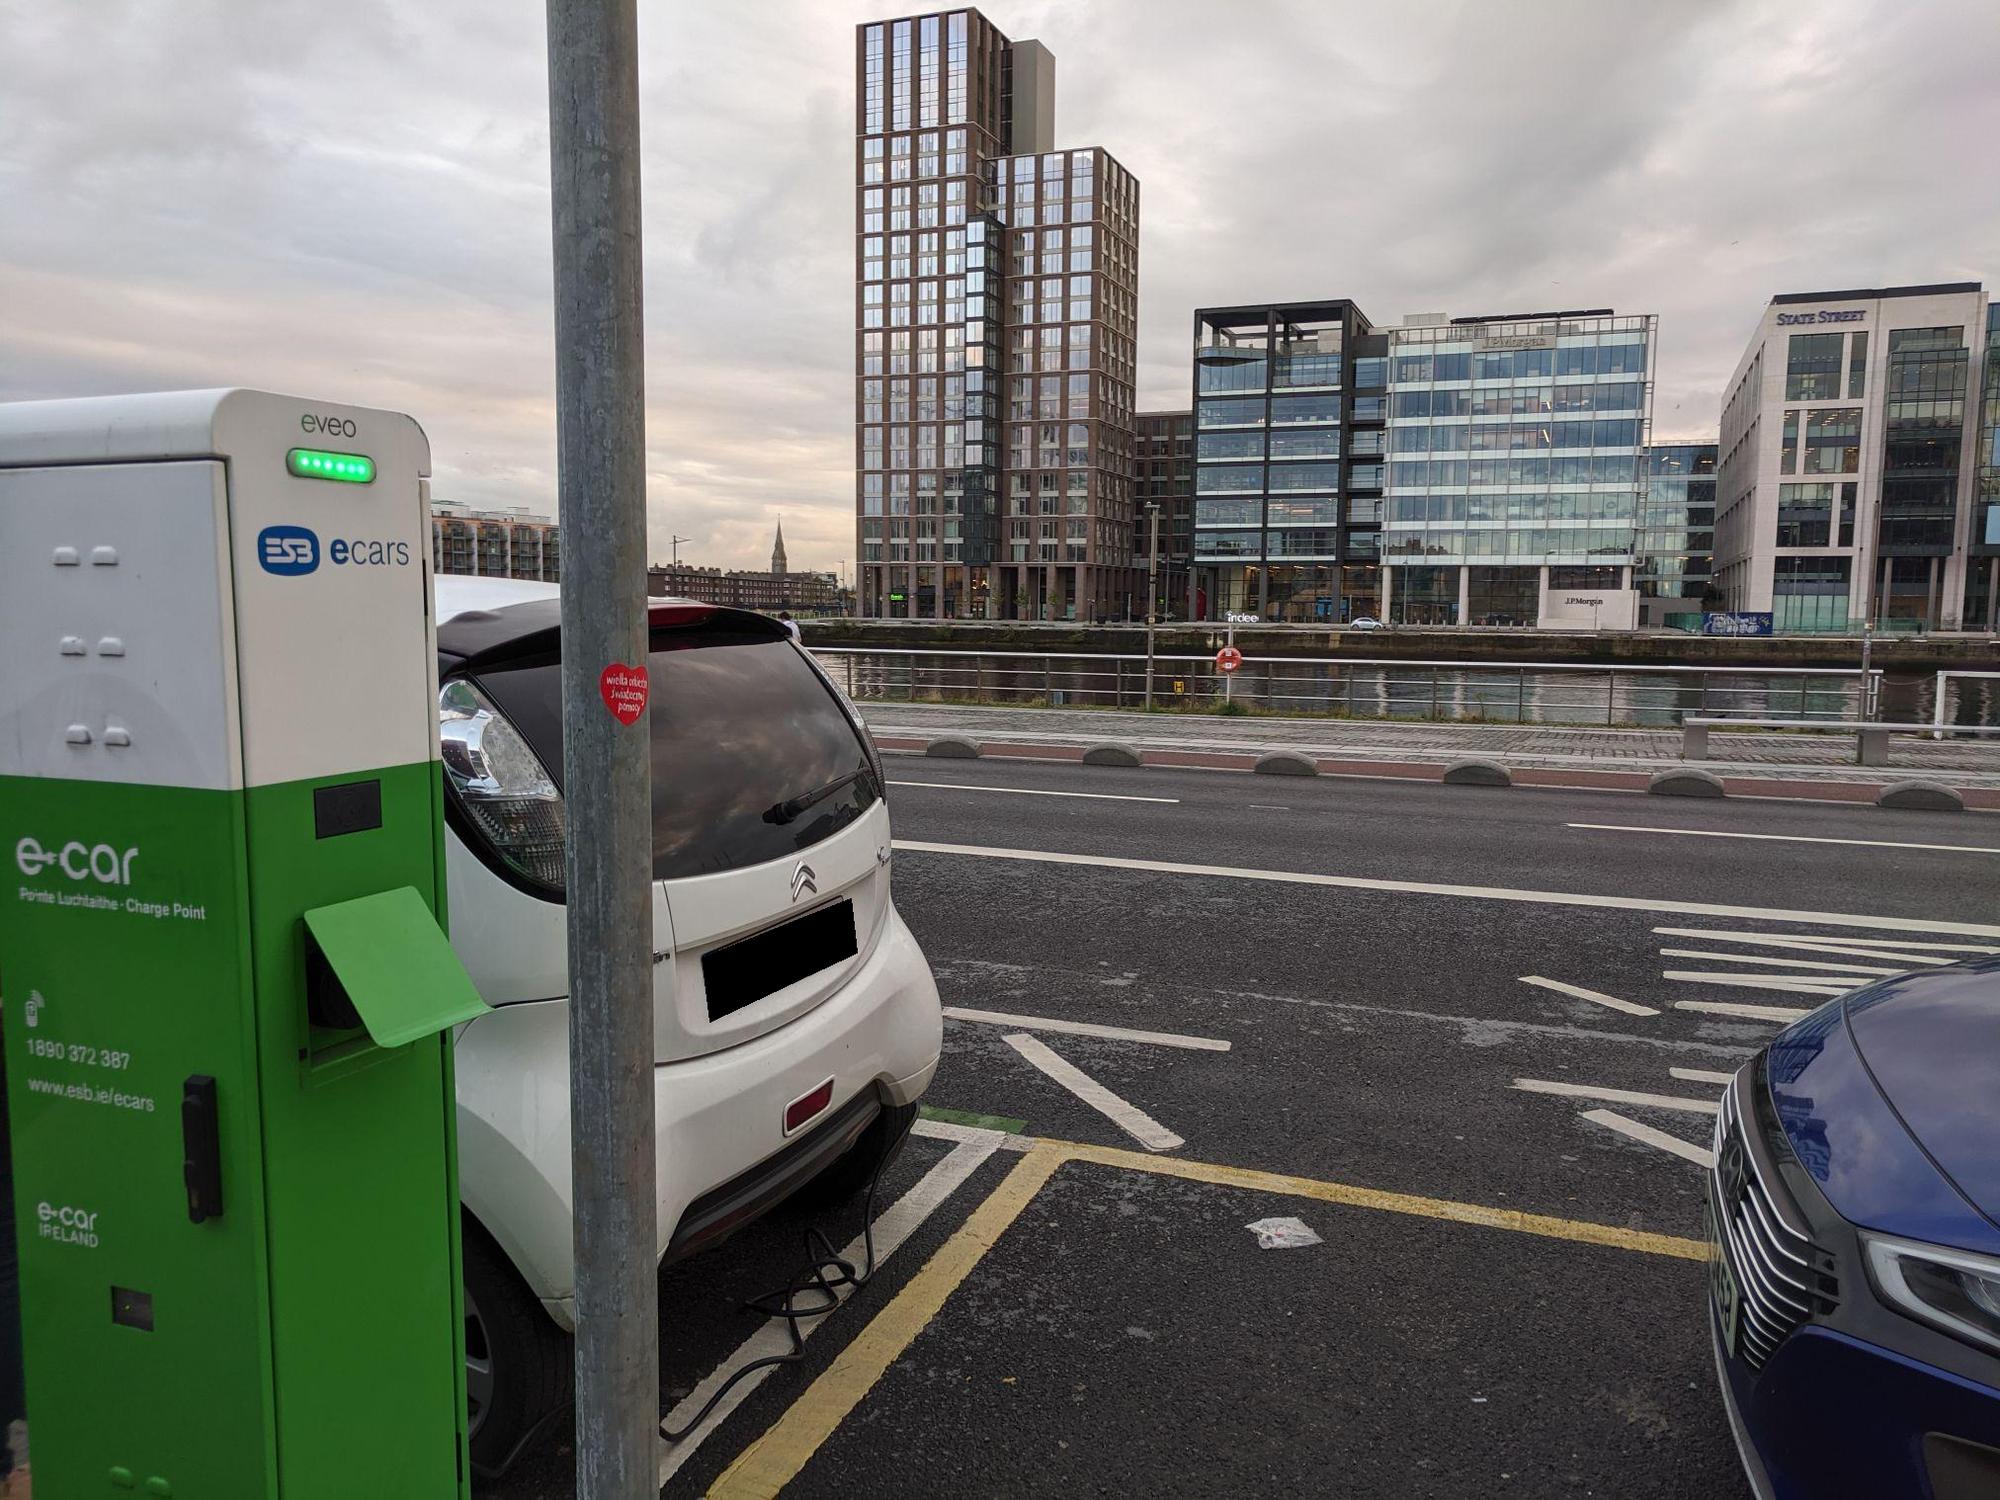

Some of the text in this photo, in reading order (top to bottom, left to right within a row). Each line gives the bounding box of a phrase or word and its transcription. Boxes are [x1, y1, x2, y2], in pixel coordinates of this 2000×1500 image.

[1776, 310, 1866, 325] STATE STREET
[301, 414, 357, 438] eveo
[265, 537, 410, 565] ESB ecars
[1225, 611, 1259, 623] indee
[126, 898, 170, 918] Charge
[173, 903, 206, 920] Point
[27, 1038, 130, 1070] 1890 372 387
[27, 1078, 155, 1112] www.esb.ie/ecars
[39, 1222, 99, 1248] IRELAND
